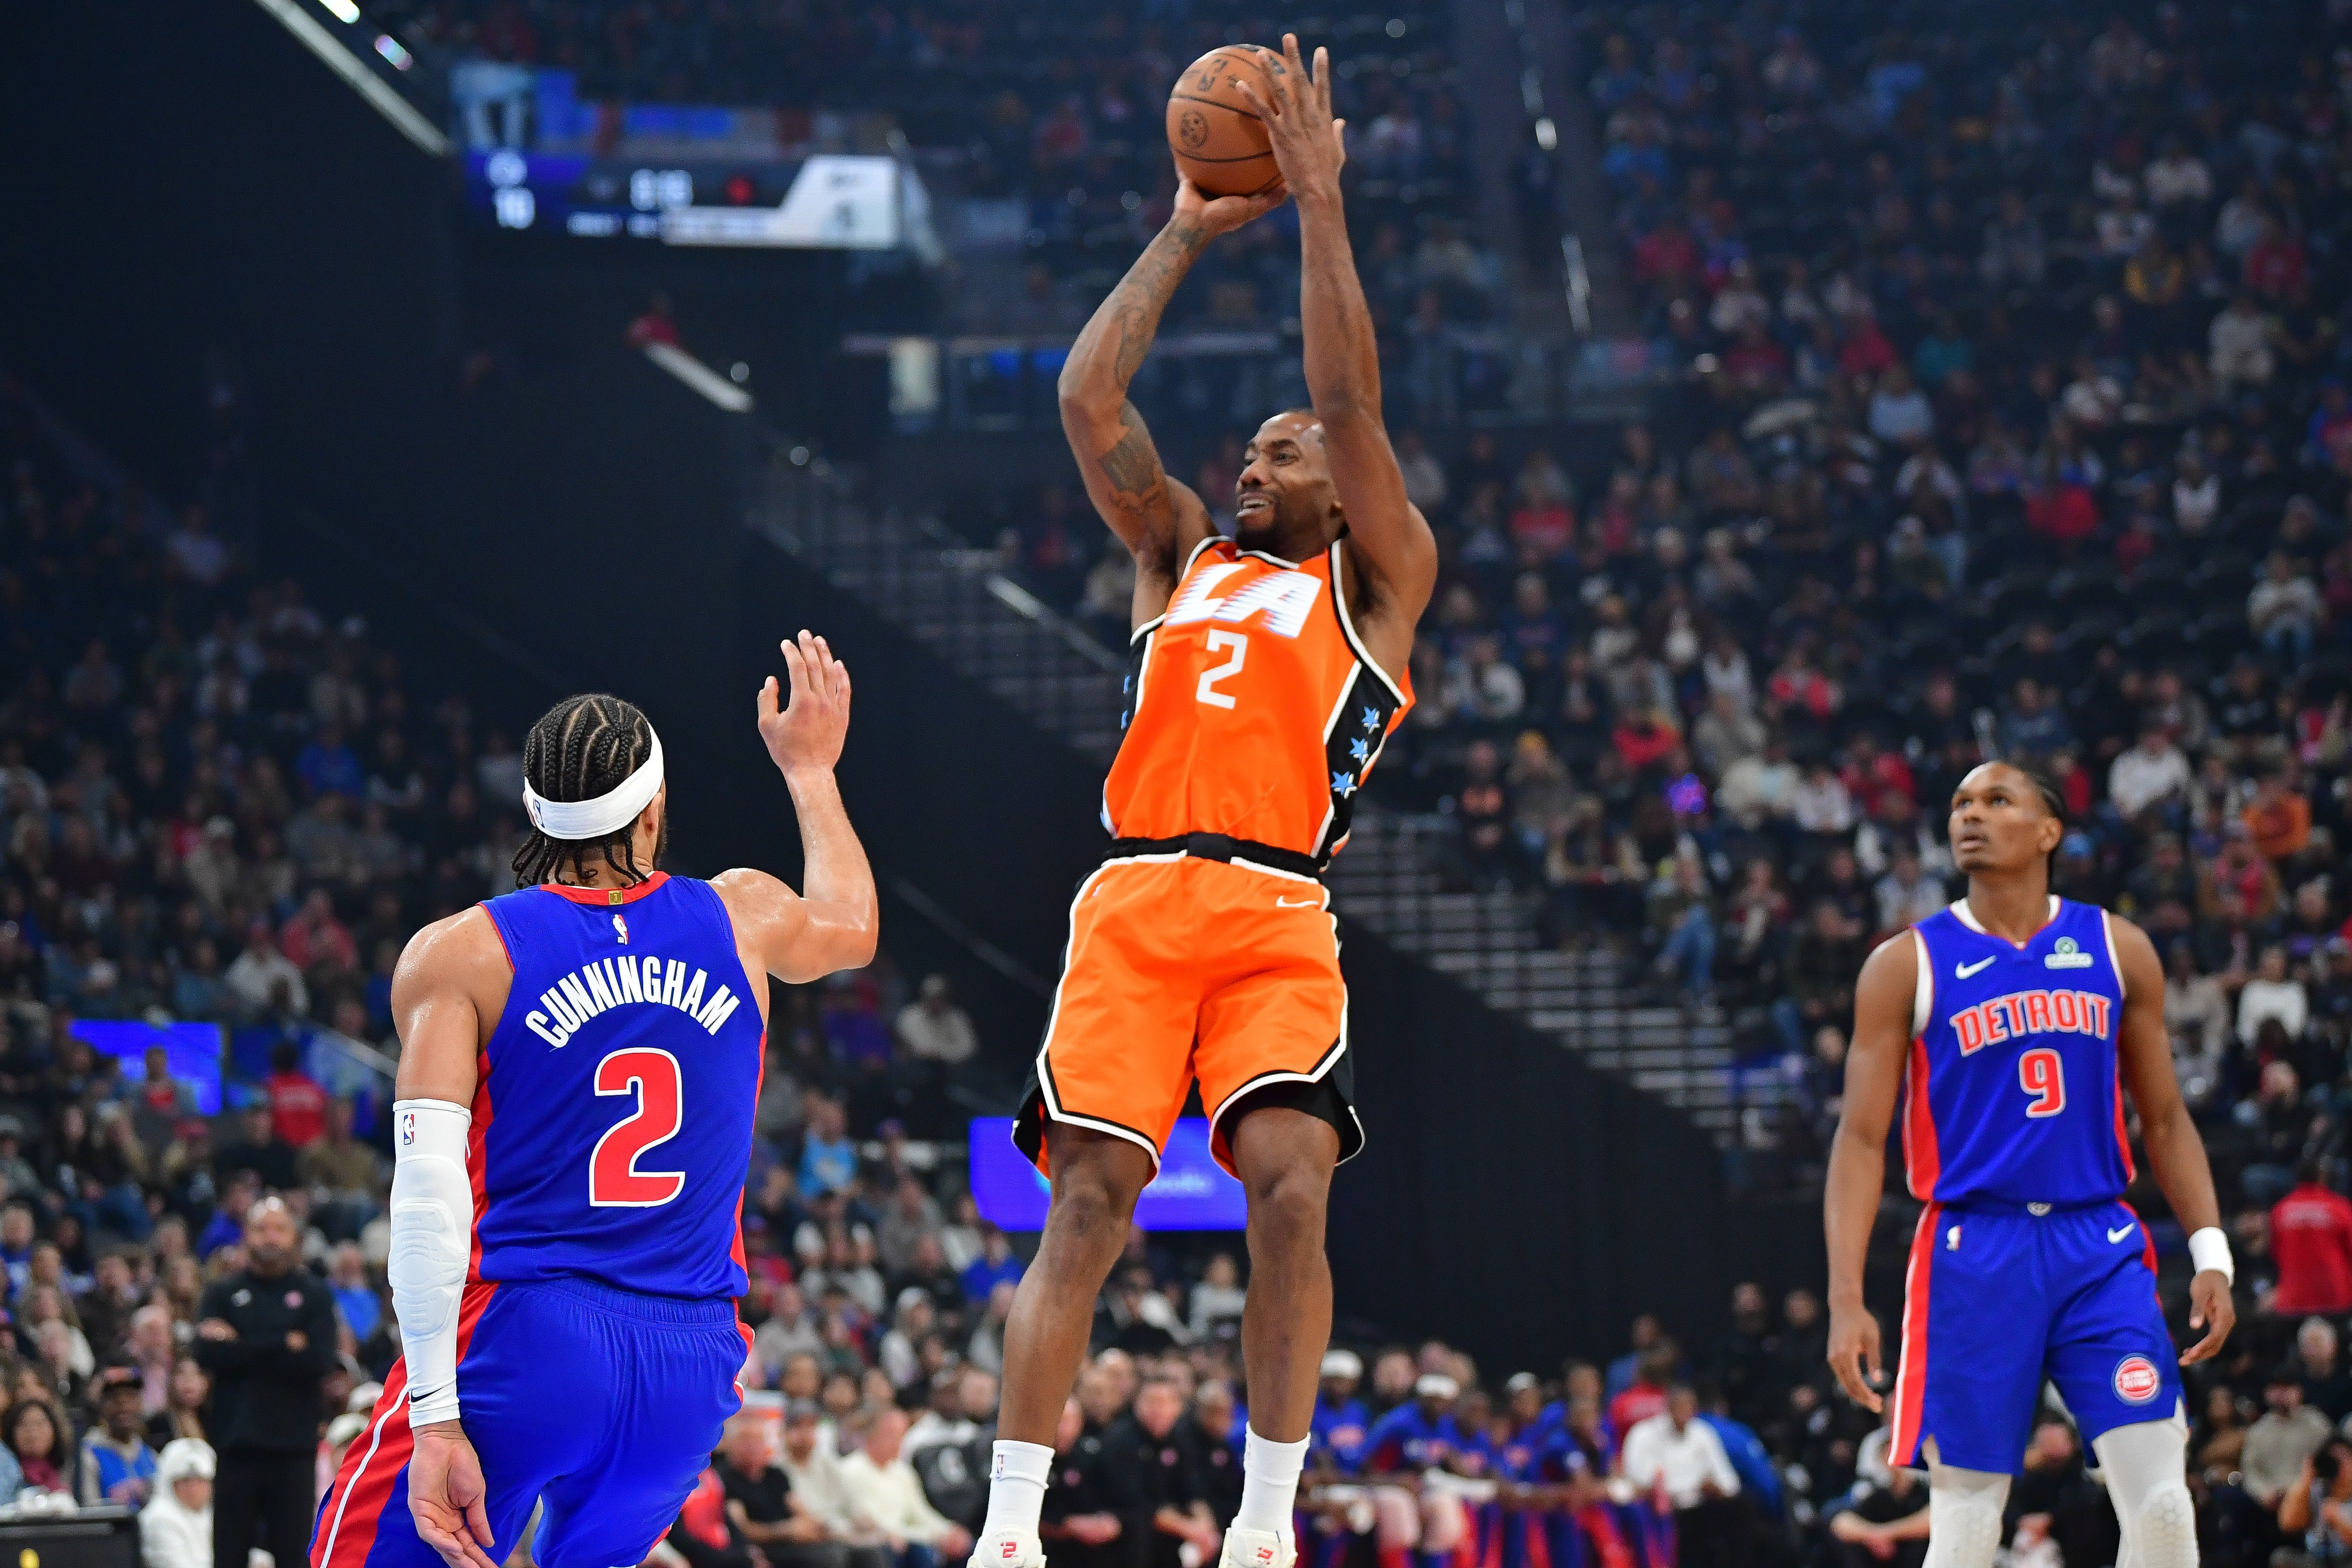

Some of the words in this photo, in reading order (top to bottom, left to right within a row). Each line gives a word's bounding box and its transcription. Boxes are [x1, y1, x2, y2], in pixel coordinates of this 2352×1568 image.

[1164, 563, 1322, 638] LA
[1195, 629, 1248, 710] 2
[525, 955, 740, 1048] CUNNINGHAM
[1949, 988, 2112, 1058] DETROIT
[2018, 1048, 2067, 1119] 9
[589, 1047, 685, 1207] 2
